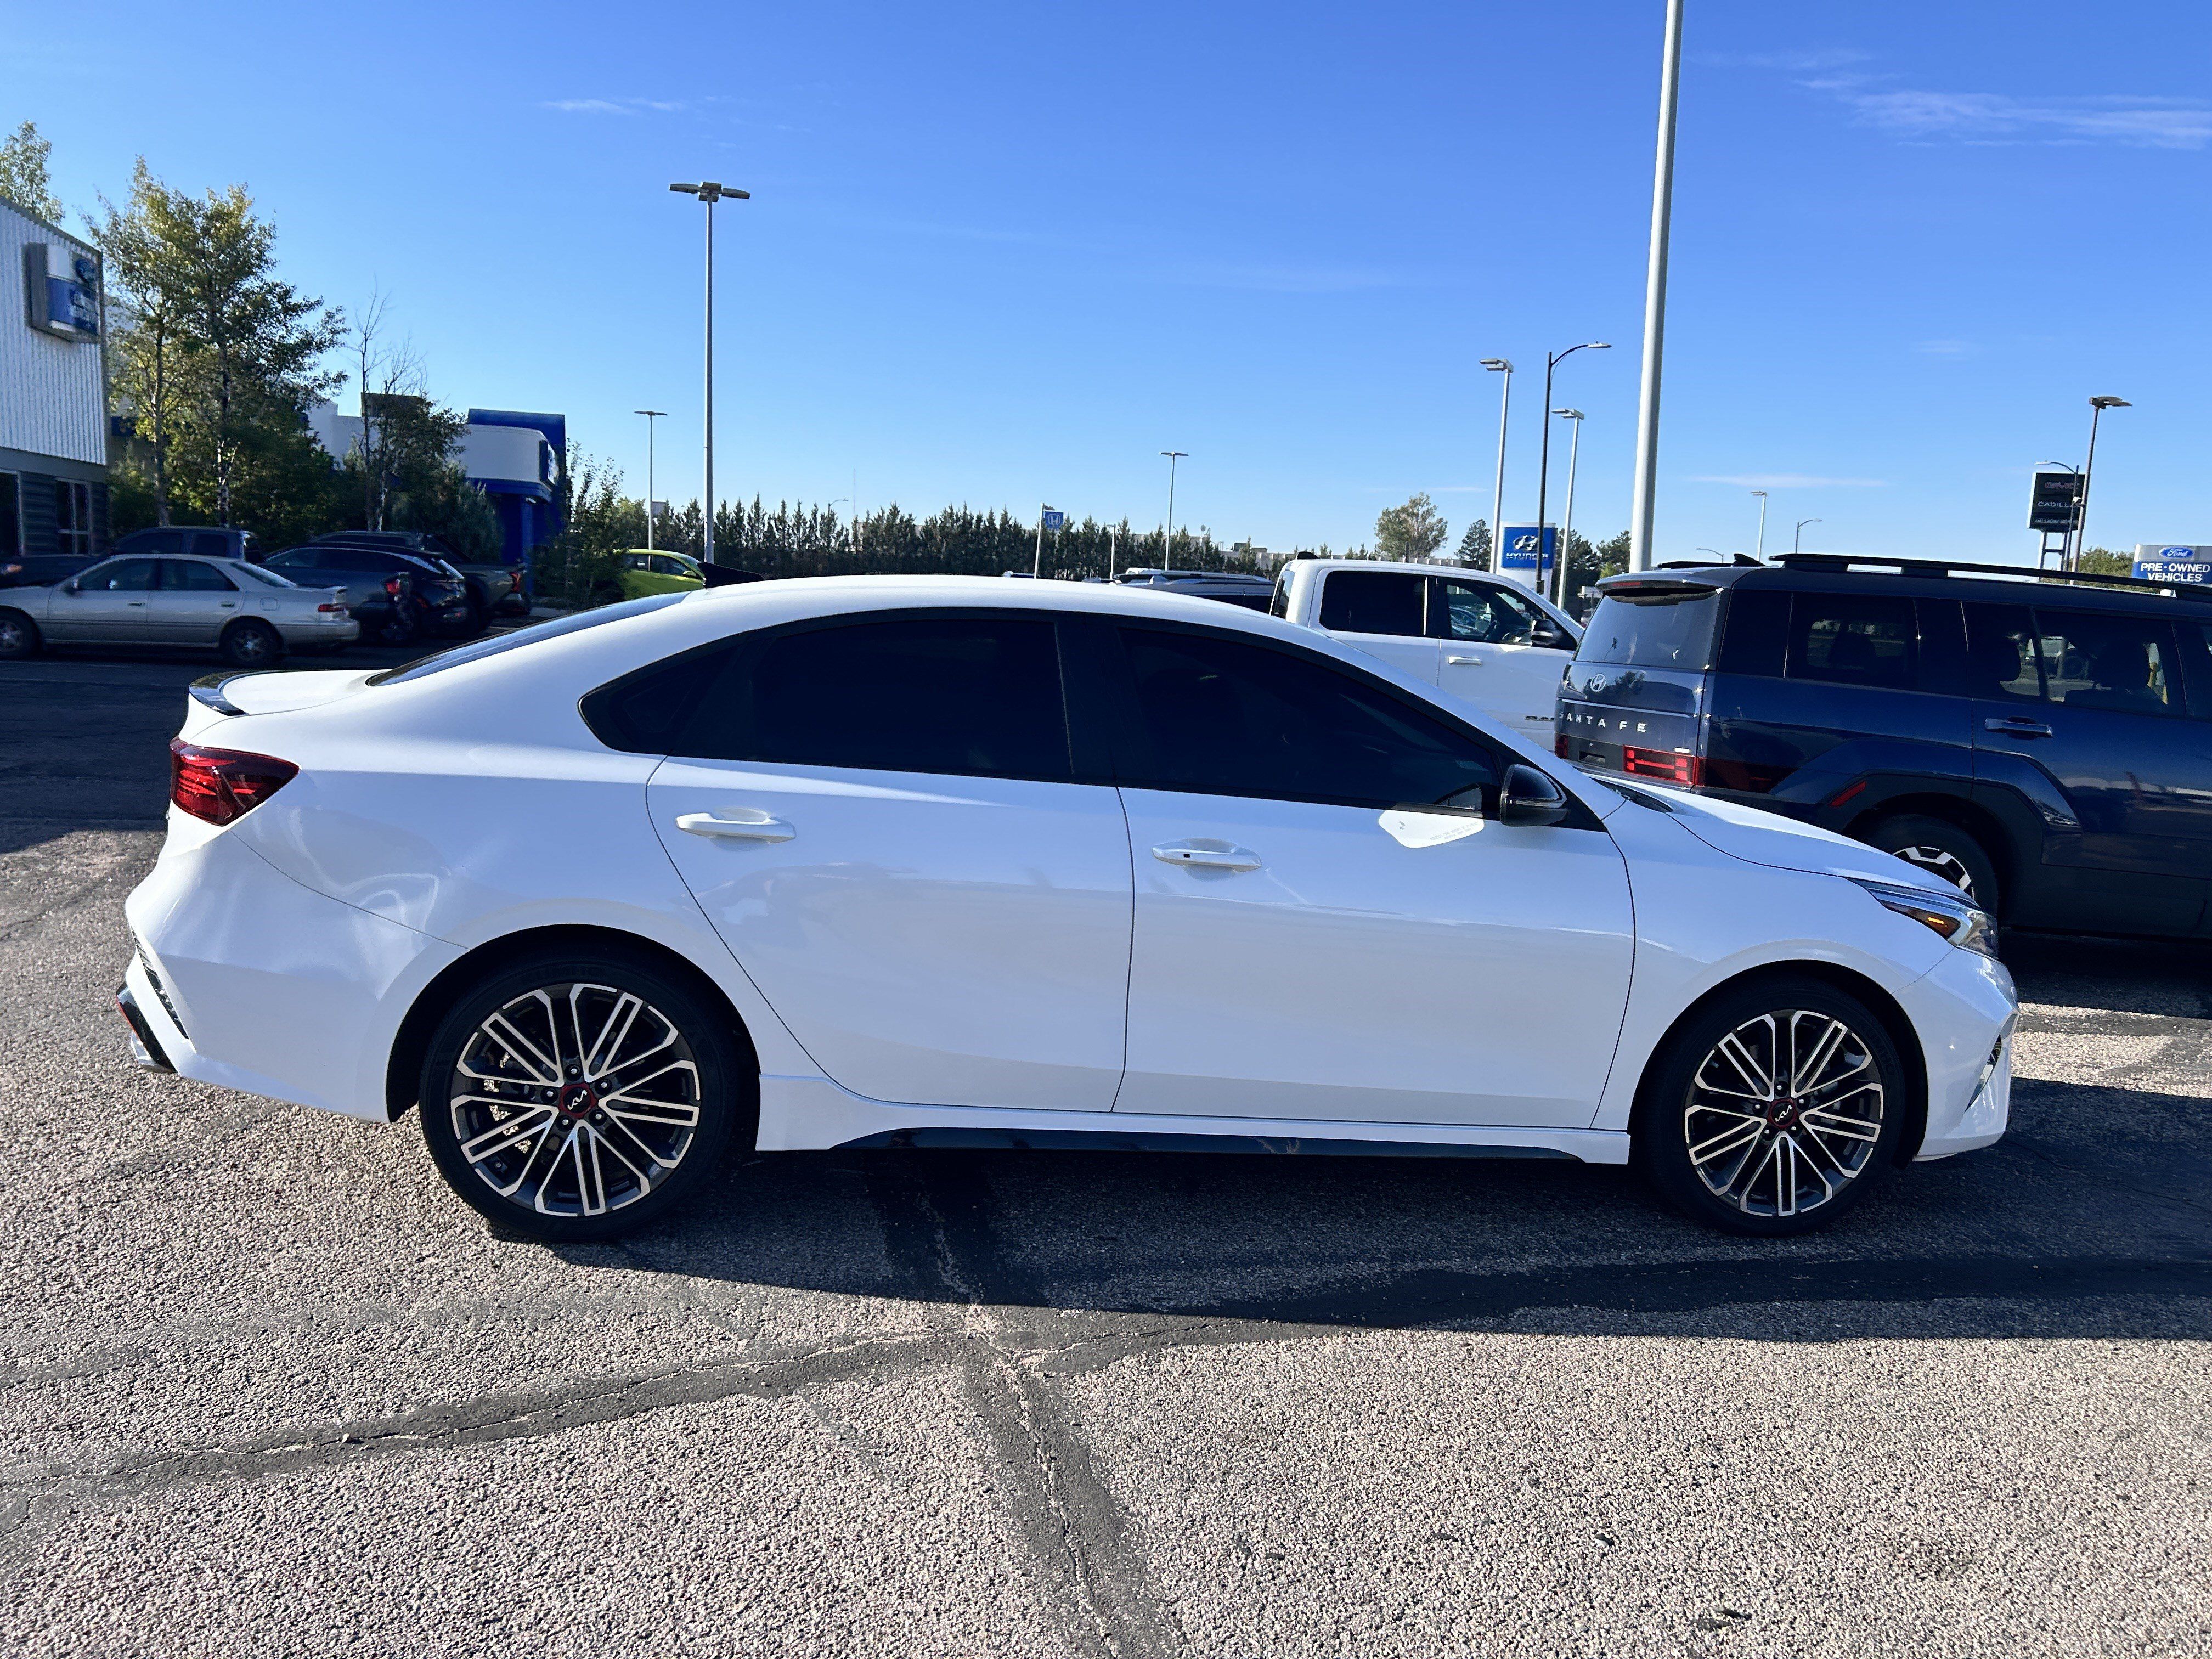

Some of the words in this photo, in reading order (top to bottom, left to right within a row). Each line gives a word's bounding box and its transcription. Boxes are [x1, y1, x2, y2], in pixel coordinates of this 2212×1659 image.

[2166, 548, 2188, 557] Ford
[2140, 562, 2211, 573] PRE-OWNED
[2147, 572, 2203, 582] VEHICLES
[1559, 711, 1606, 728] SANTA
[1619, 720, 1646, 733] FE
